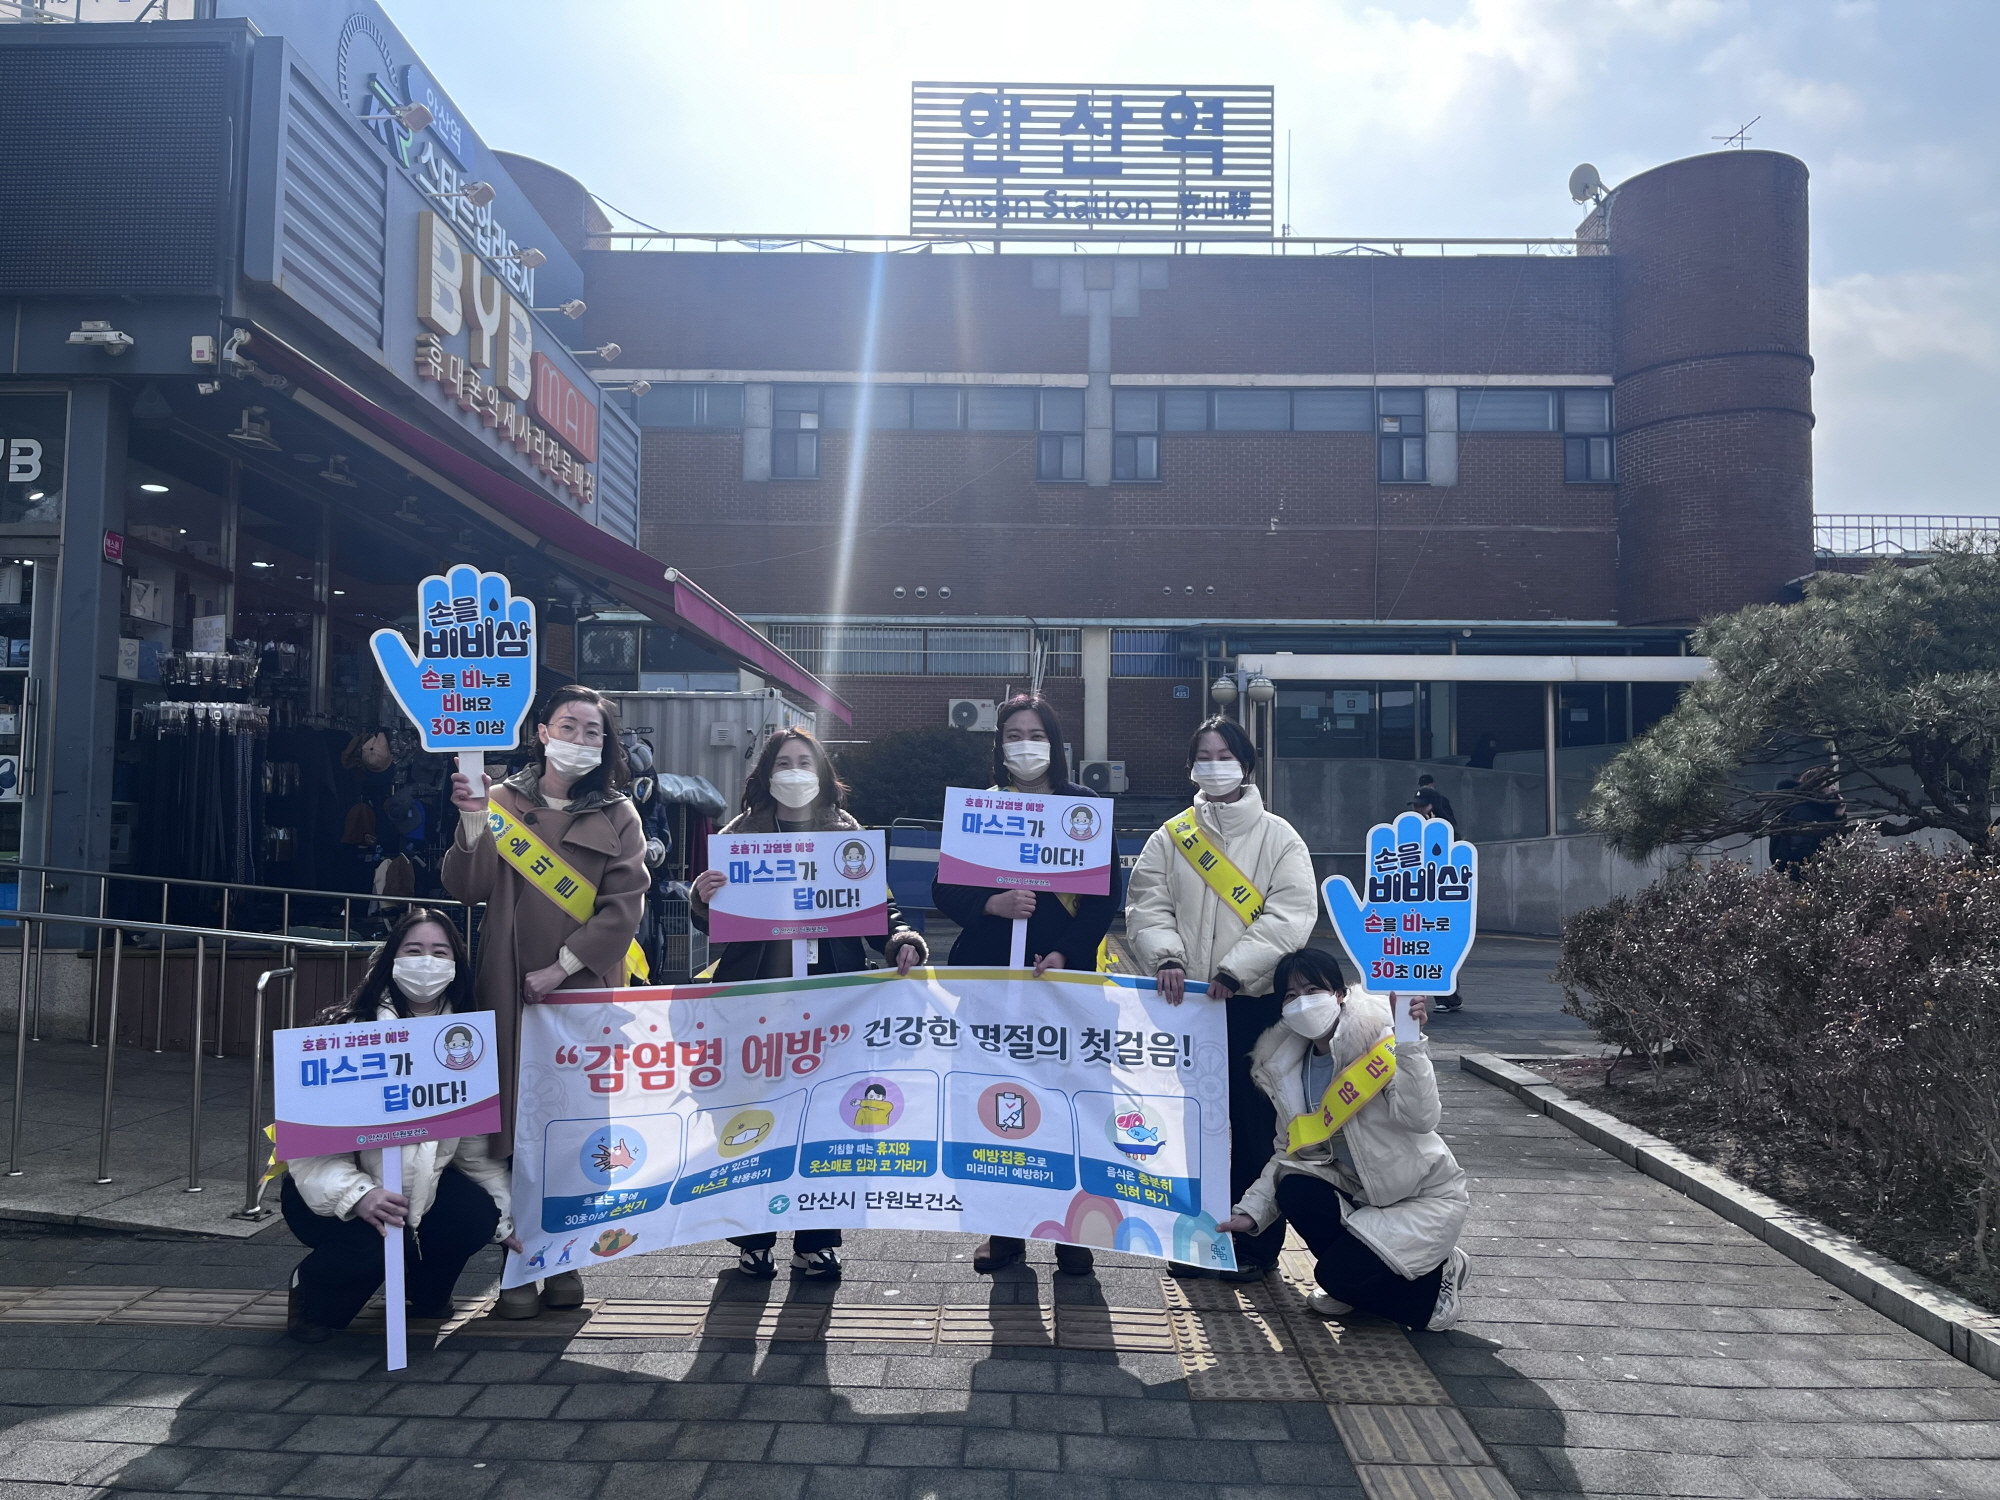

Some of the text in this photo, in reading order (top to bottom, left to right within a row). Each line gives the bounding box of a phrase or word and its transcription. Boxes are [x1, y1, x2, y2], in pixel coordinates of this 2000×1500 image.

[427, 87, 462, 155] 안산역
[960, 92, 1223, 176] 안산역
[936, 189, 1153, 219] Ansan Station
[419, 211, 533, 400] BYB
[416, 333, 596, 504] 휴대폰악세사리전문매장
[428, 596, 479, 627] 손을
[423, 617, 532, 659] 비비삼
[421, 667, 511, 690] 손을 비누로
[442, 692, 491, 712] 비벼요
[431, 717, 505, 736] 30초 이상
[965, 797, 1044, 812] 호흡기 감염병 예방
[962, 813, 1045, 838] 마스크가
[730, 842, 815, 855] 호흡기 감염병 예방
[1019, 843, 1084, 867] 답이다!
[1374, 842, 1422, 873] 손을
[510, 838, 579, 899] 올바른
[729, 859, 818, 884] 마스크가
[1368, 862, 1473, 902] 비비삼
[793, 887, 860, 911] 답이다!
[1364, 912, 1450, 933] 손을 비누로
[1383, 936, 1430, 956] 비벼요
[1371, 961, 1443, 979] 30초 이상
[302, 1030, 410, 1052] 호흡기 감염병 예방
[863, 1015, 1192, 1068] 건강한 명절의 첫걸음!
[301, 1052, 413, 1087] 마스크가
[383, 1080, 467, 1112] 답이다!
[368, 1128, 428, 1142] 안산시 단원보건소
[828, 1141, 910, 1156] 기침할 때는 휴지와
[972, 1147, 1048, 1169] 예방접종으로
[709, 1156, 760, 1179] 증상 있으면
[809, 1158, 927, 1174] 옷소매로 입과 코 가리기
[966, 1162, 1054, 1183] 미리미리 예방하기
[691, 1167, 771, 1194] 마스크 착용하기
[1106, 1166, 1173, 1193] 음식은 충분히
[582, 1191, 640, 1207] 흐르는 물에
[797, 1191, 964, 1212] 안산시 단원보건소
[1115, 1182, 1169, 1206] 익혀 먹기
[609, 1198, 648, 1217] 손씻기
